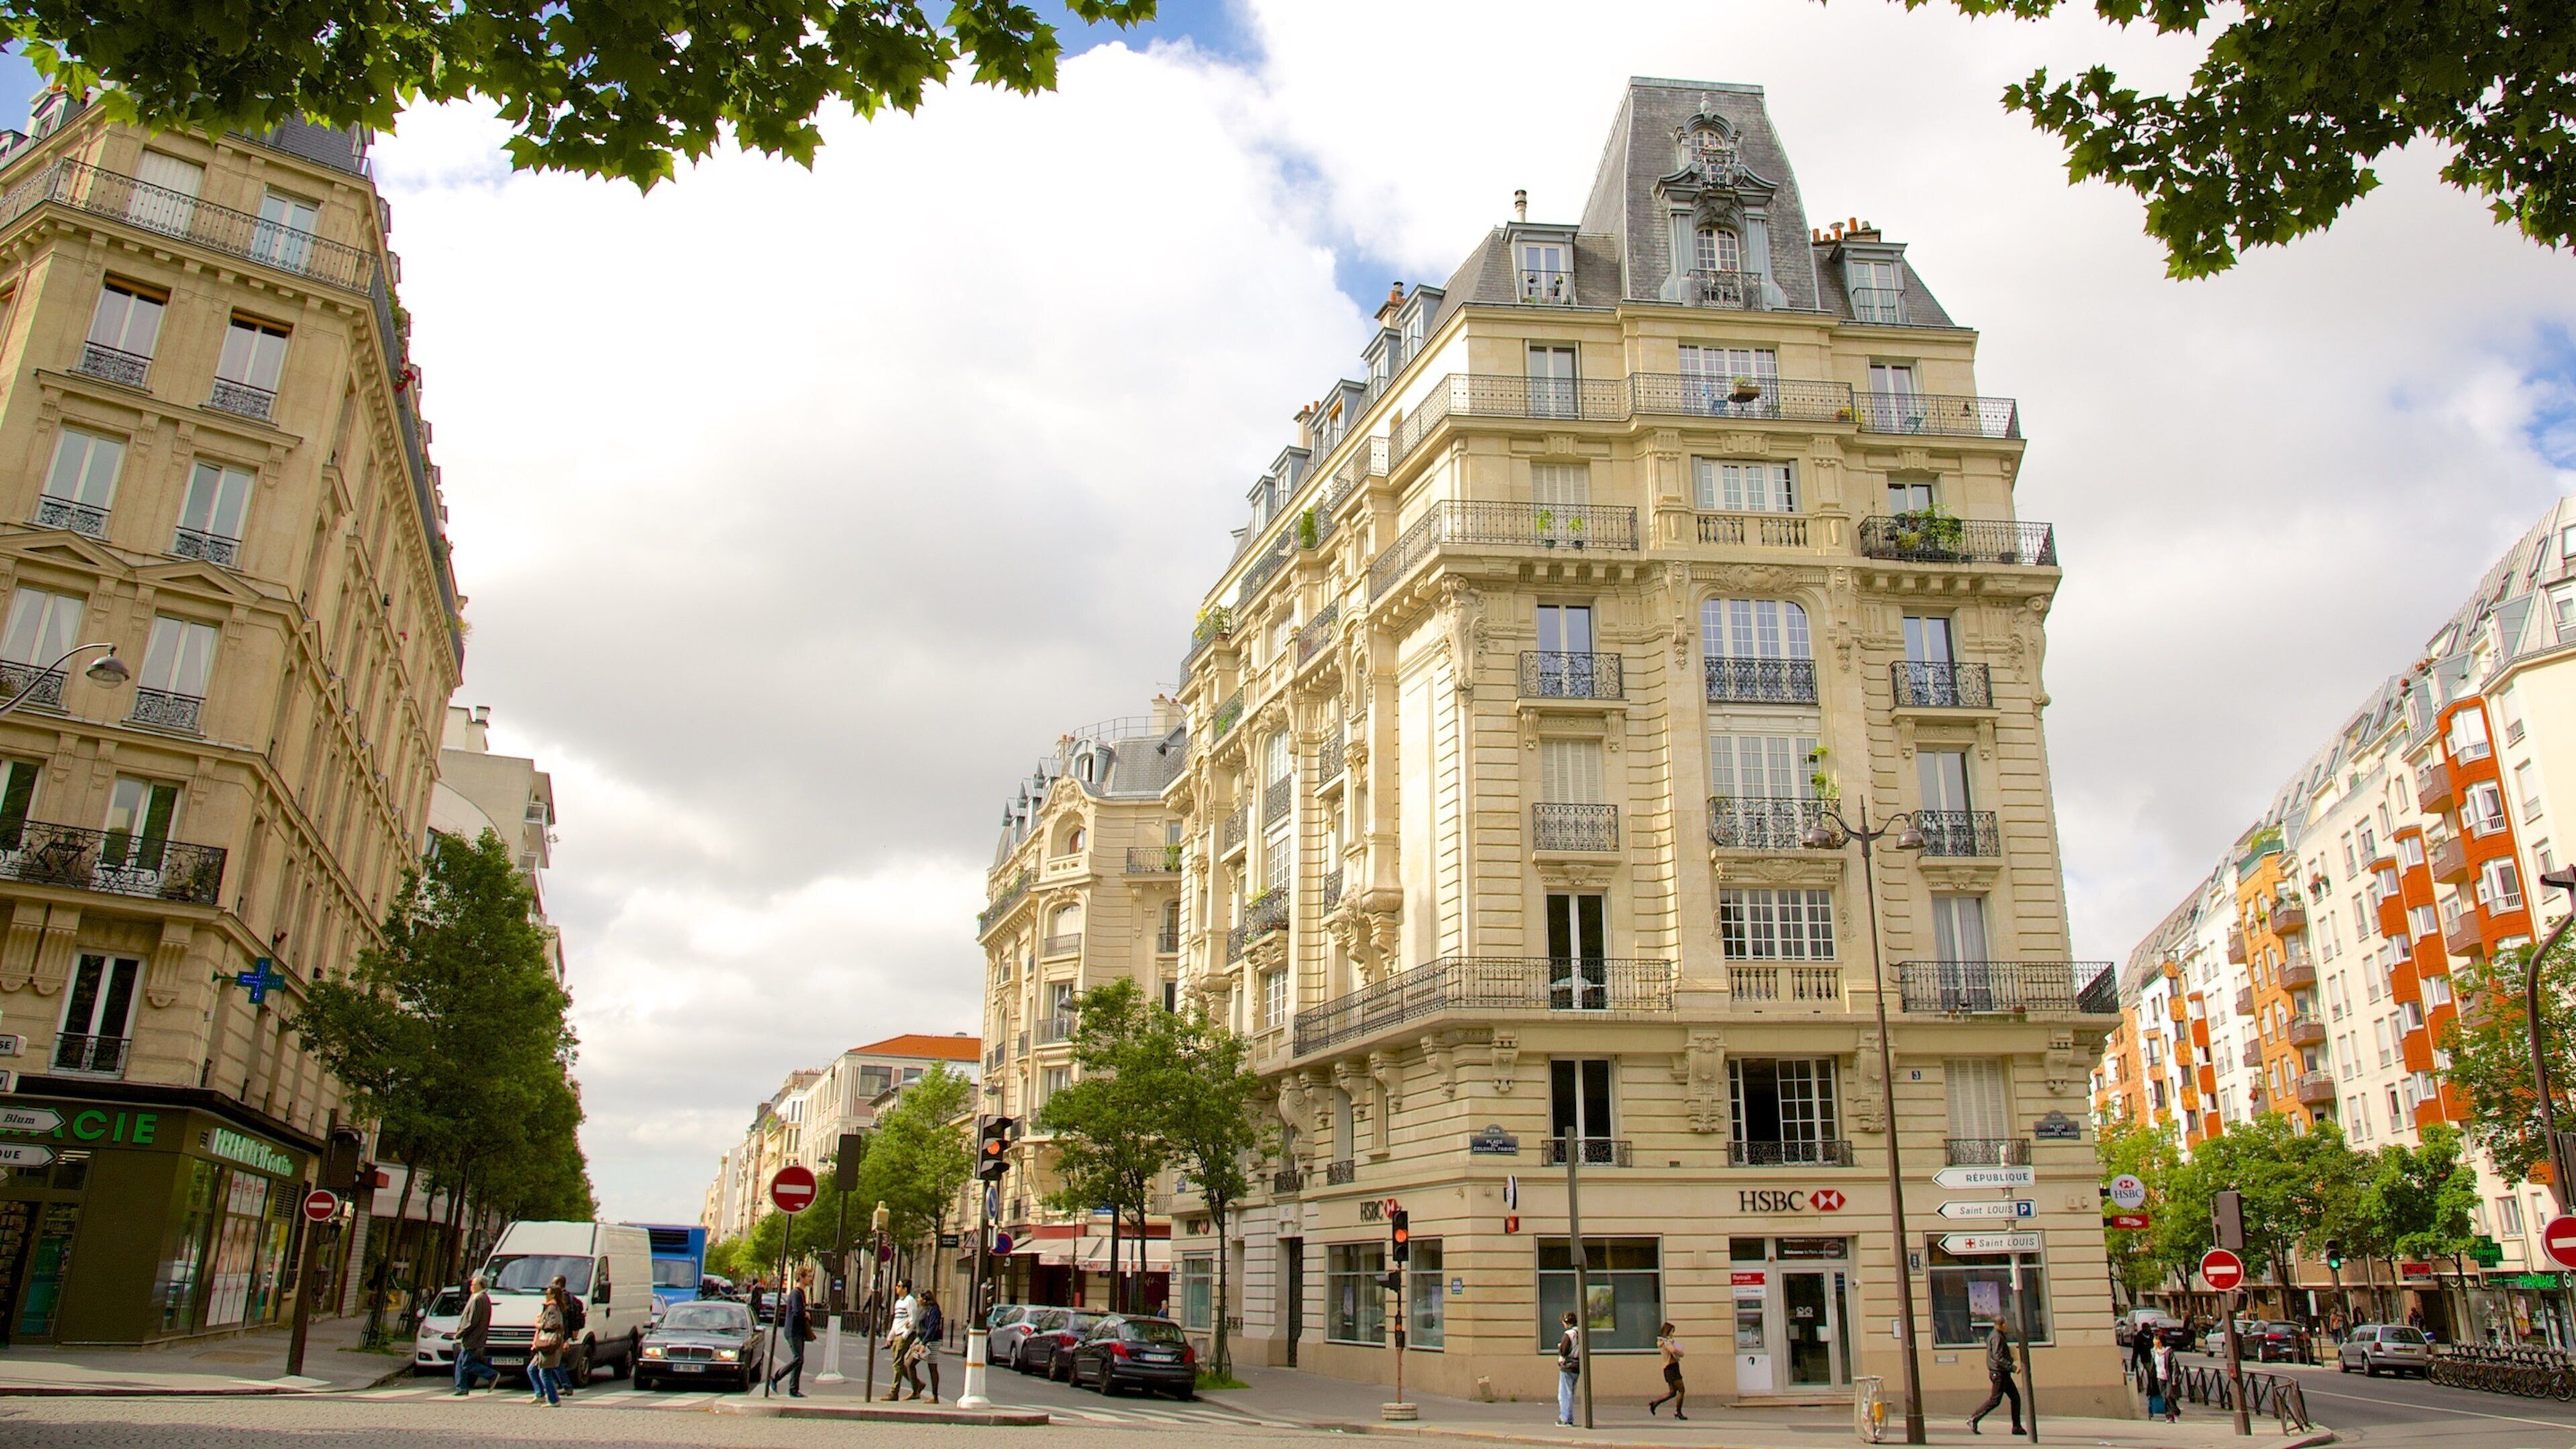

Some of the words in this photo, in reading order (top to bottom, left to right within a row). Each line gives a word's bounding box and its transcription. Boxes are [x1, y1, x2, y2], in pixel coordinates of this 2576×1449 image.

[4, 1114, 35, 1124] Blum
[1966, 1172, 2029, 1182] RÉPUBLIQUE
[2114, 1189, 2143, 1199] HSBC
[1738, 1190, 1805, 1212] HSBC
[1360, 1200, 1383, 1222] HSBC
[1960, 1207, 1982, 1215] Saint
[1988, 1205, 2013, 1214] LOUIS
[1979, 1239, 2003, 1247] Saint
[2008, 1238, 2035, 1246] LOUIS
[2518, 1275, 2558, 1288] PHARMACIE
